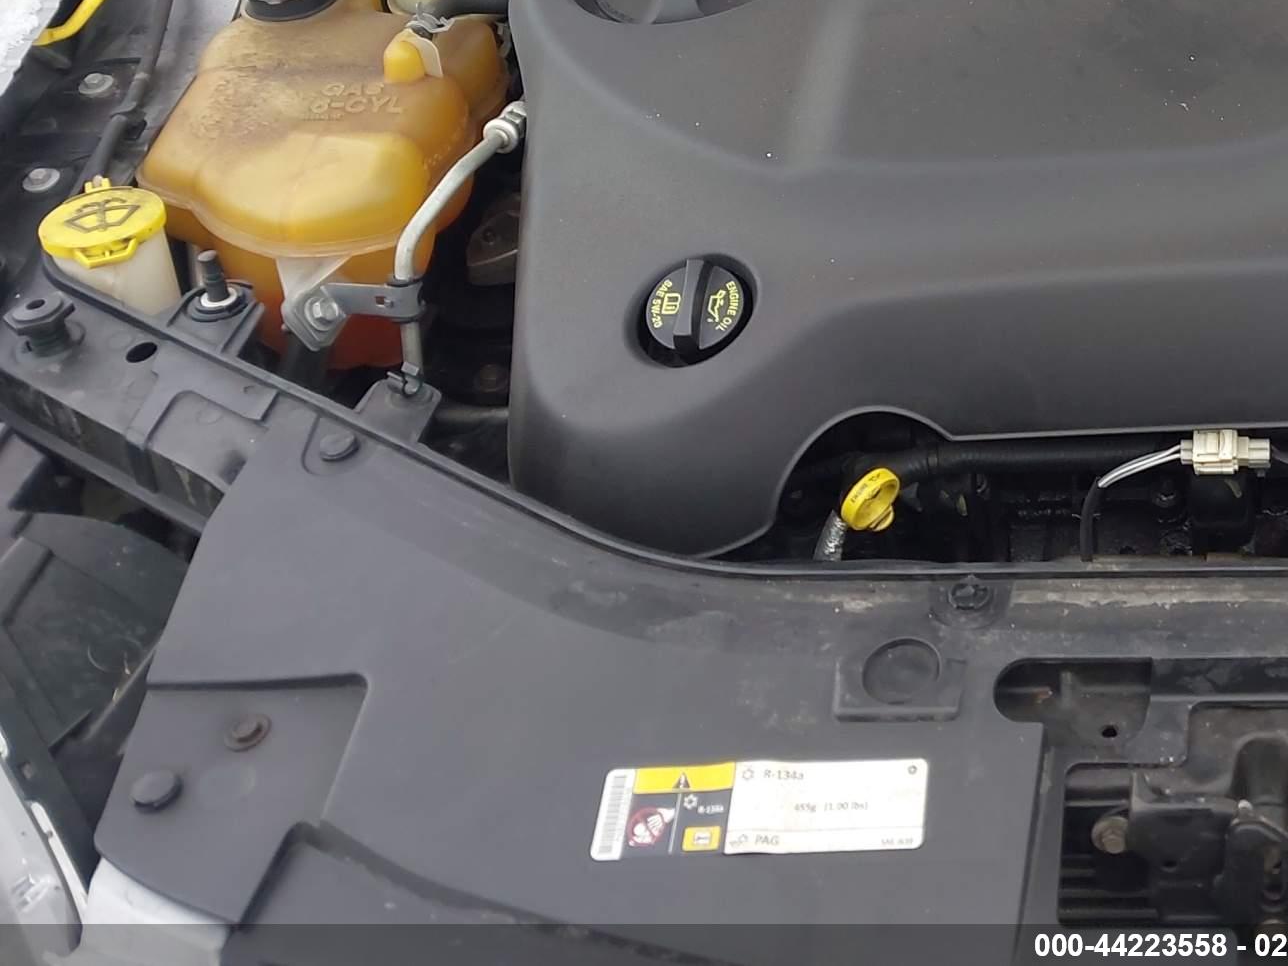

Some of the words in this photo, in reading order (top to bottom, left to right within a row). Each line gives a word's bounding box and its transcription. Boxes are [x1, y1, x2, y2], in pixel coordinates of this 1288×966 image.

[726, 281, 739, 316] ENGINE
[715, 317, 732, 331] OIL
[763, 769, 804, 780] R-134a
[755, 835, 780, 846] PAG
